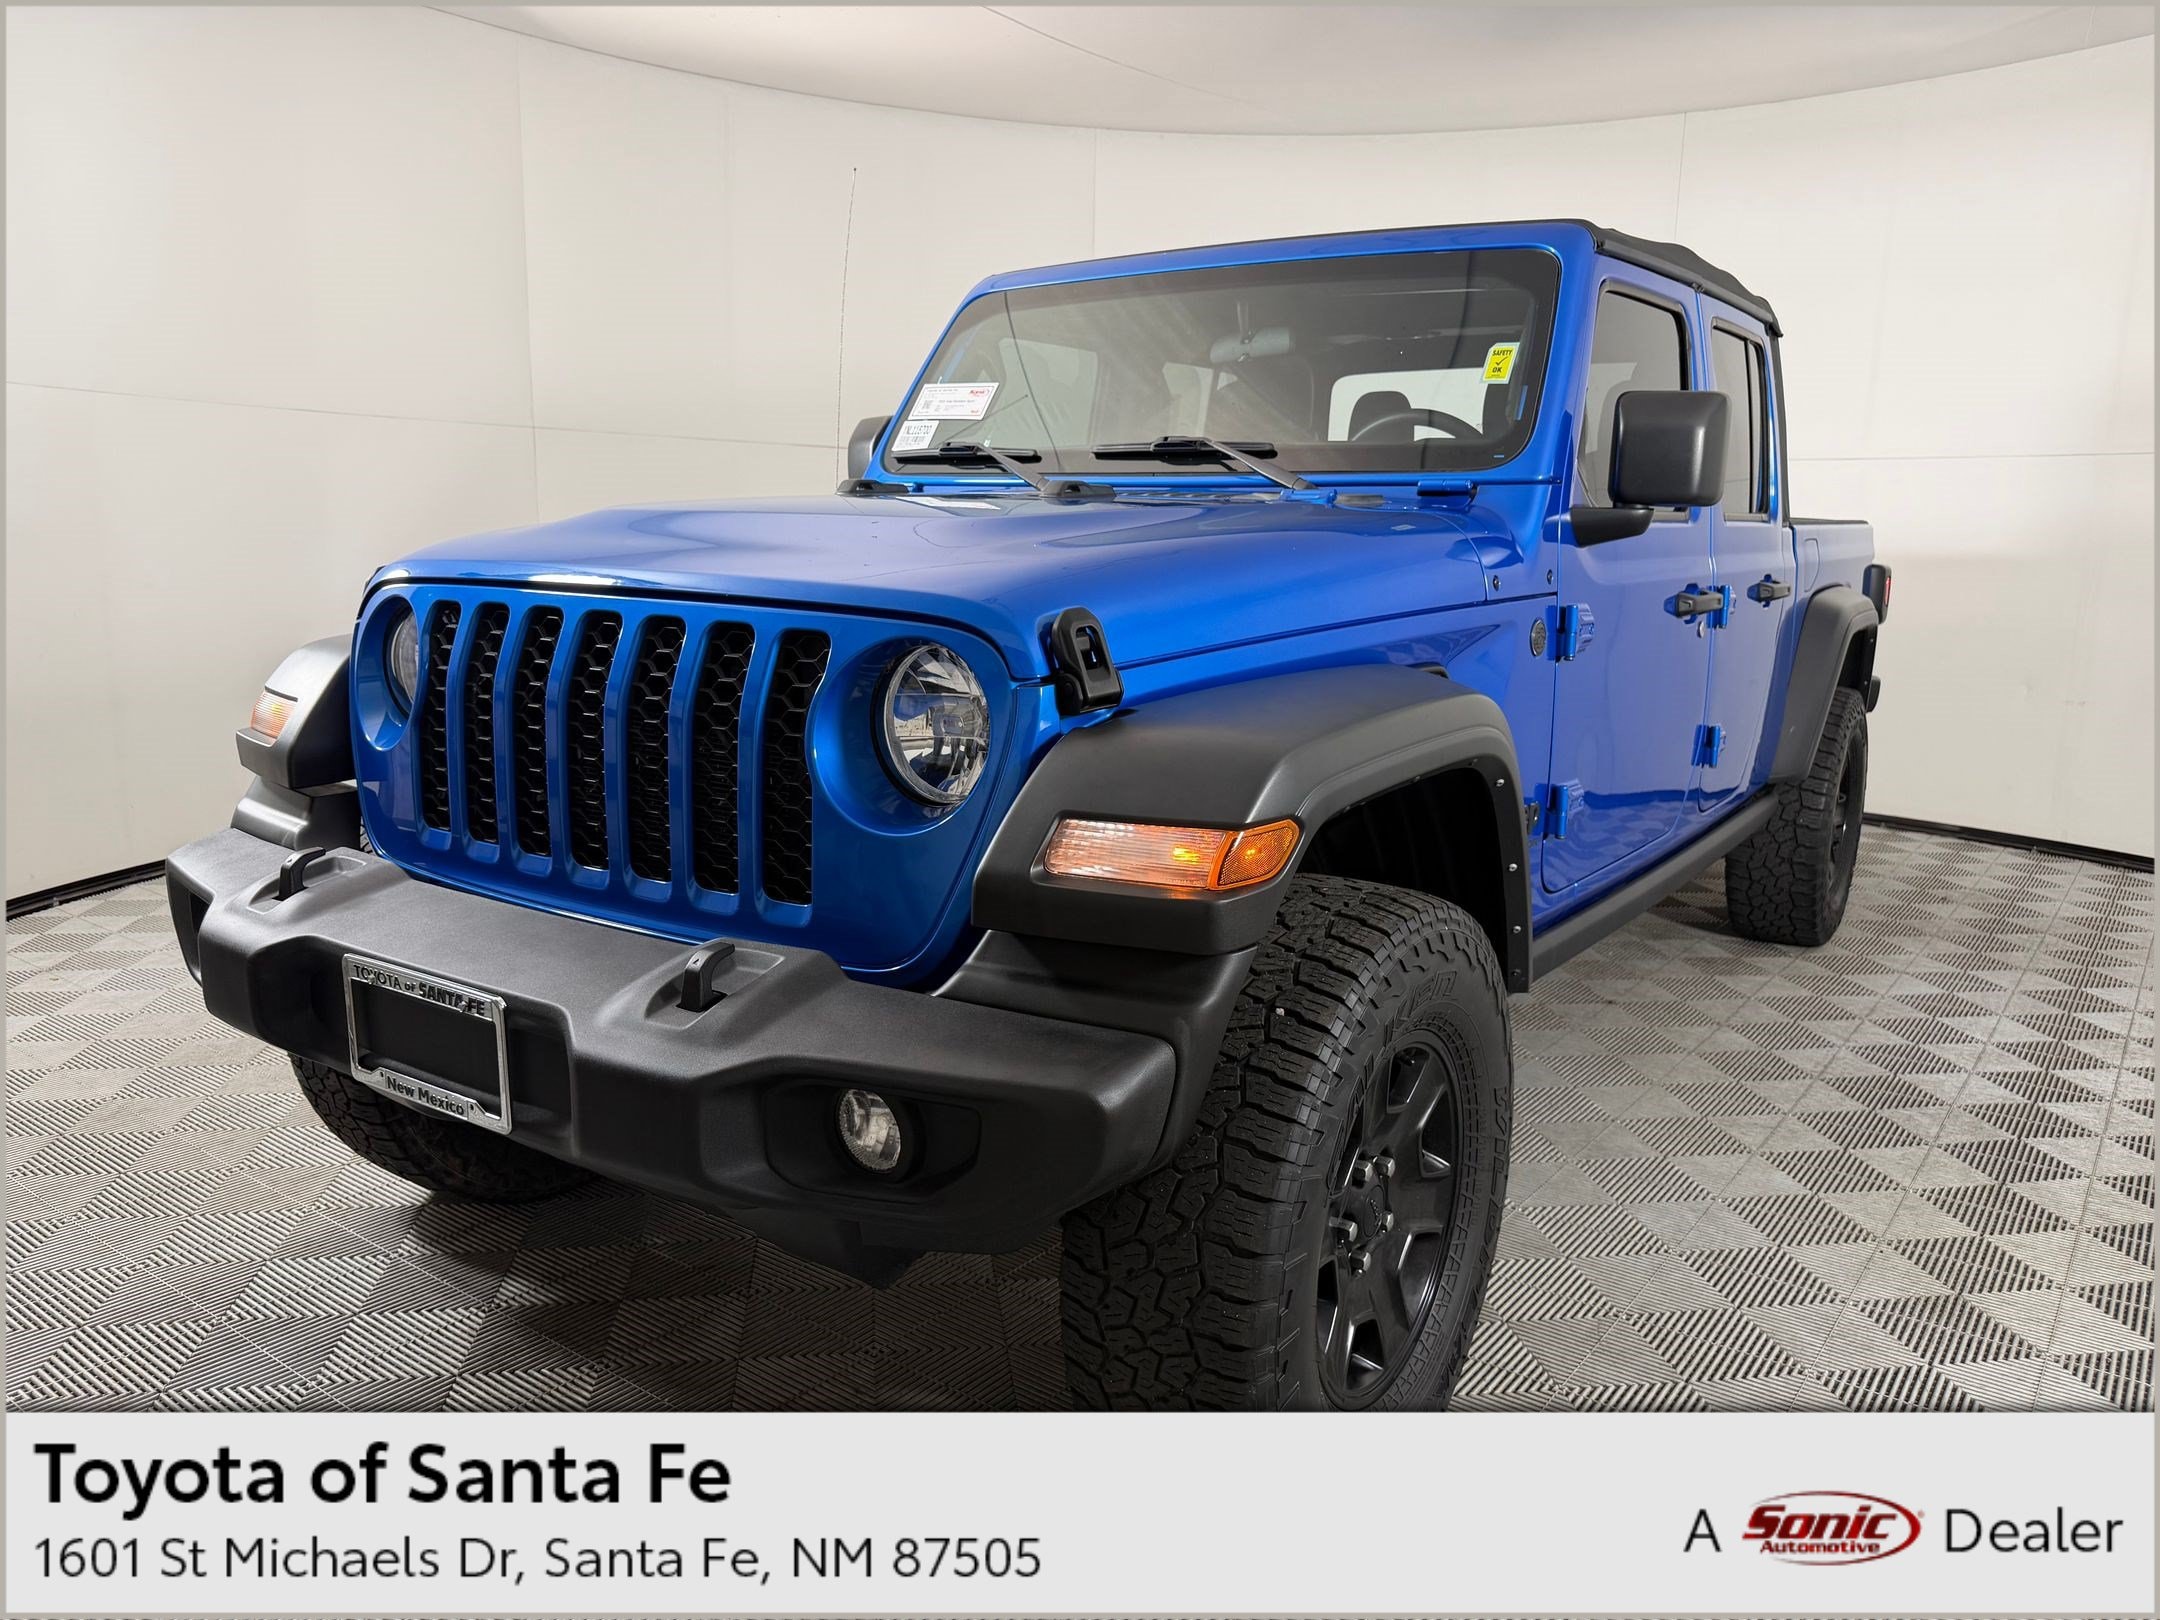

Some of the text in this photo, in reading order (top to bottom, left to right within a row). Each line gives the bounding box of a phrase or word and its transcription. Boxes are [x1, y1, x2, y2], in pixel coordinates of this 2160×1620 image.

[353, 964, 402, 991] TOYOTA
[418, 984, 467, 1009] SANTA
[467, 997, 485, 1016] FE
[386, 1075, 465, 1116] New Mexico
